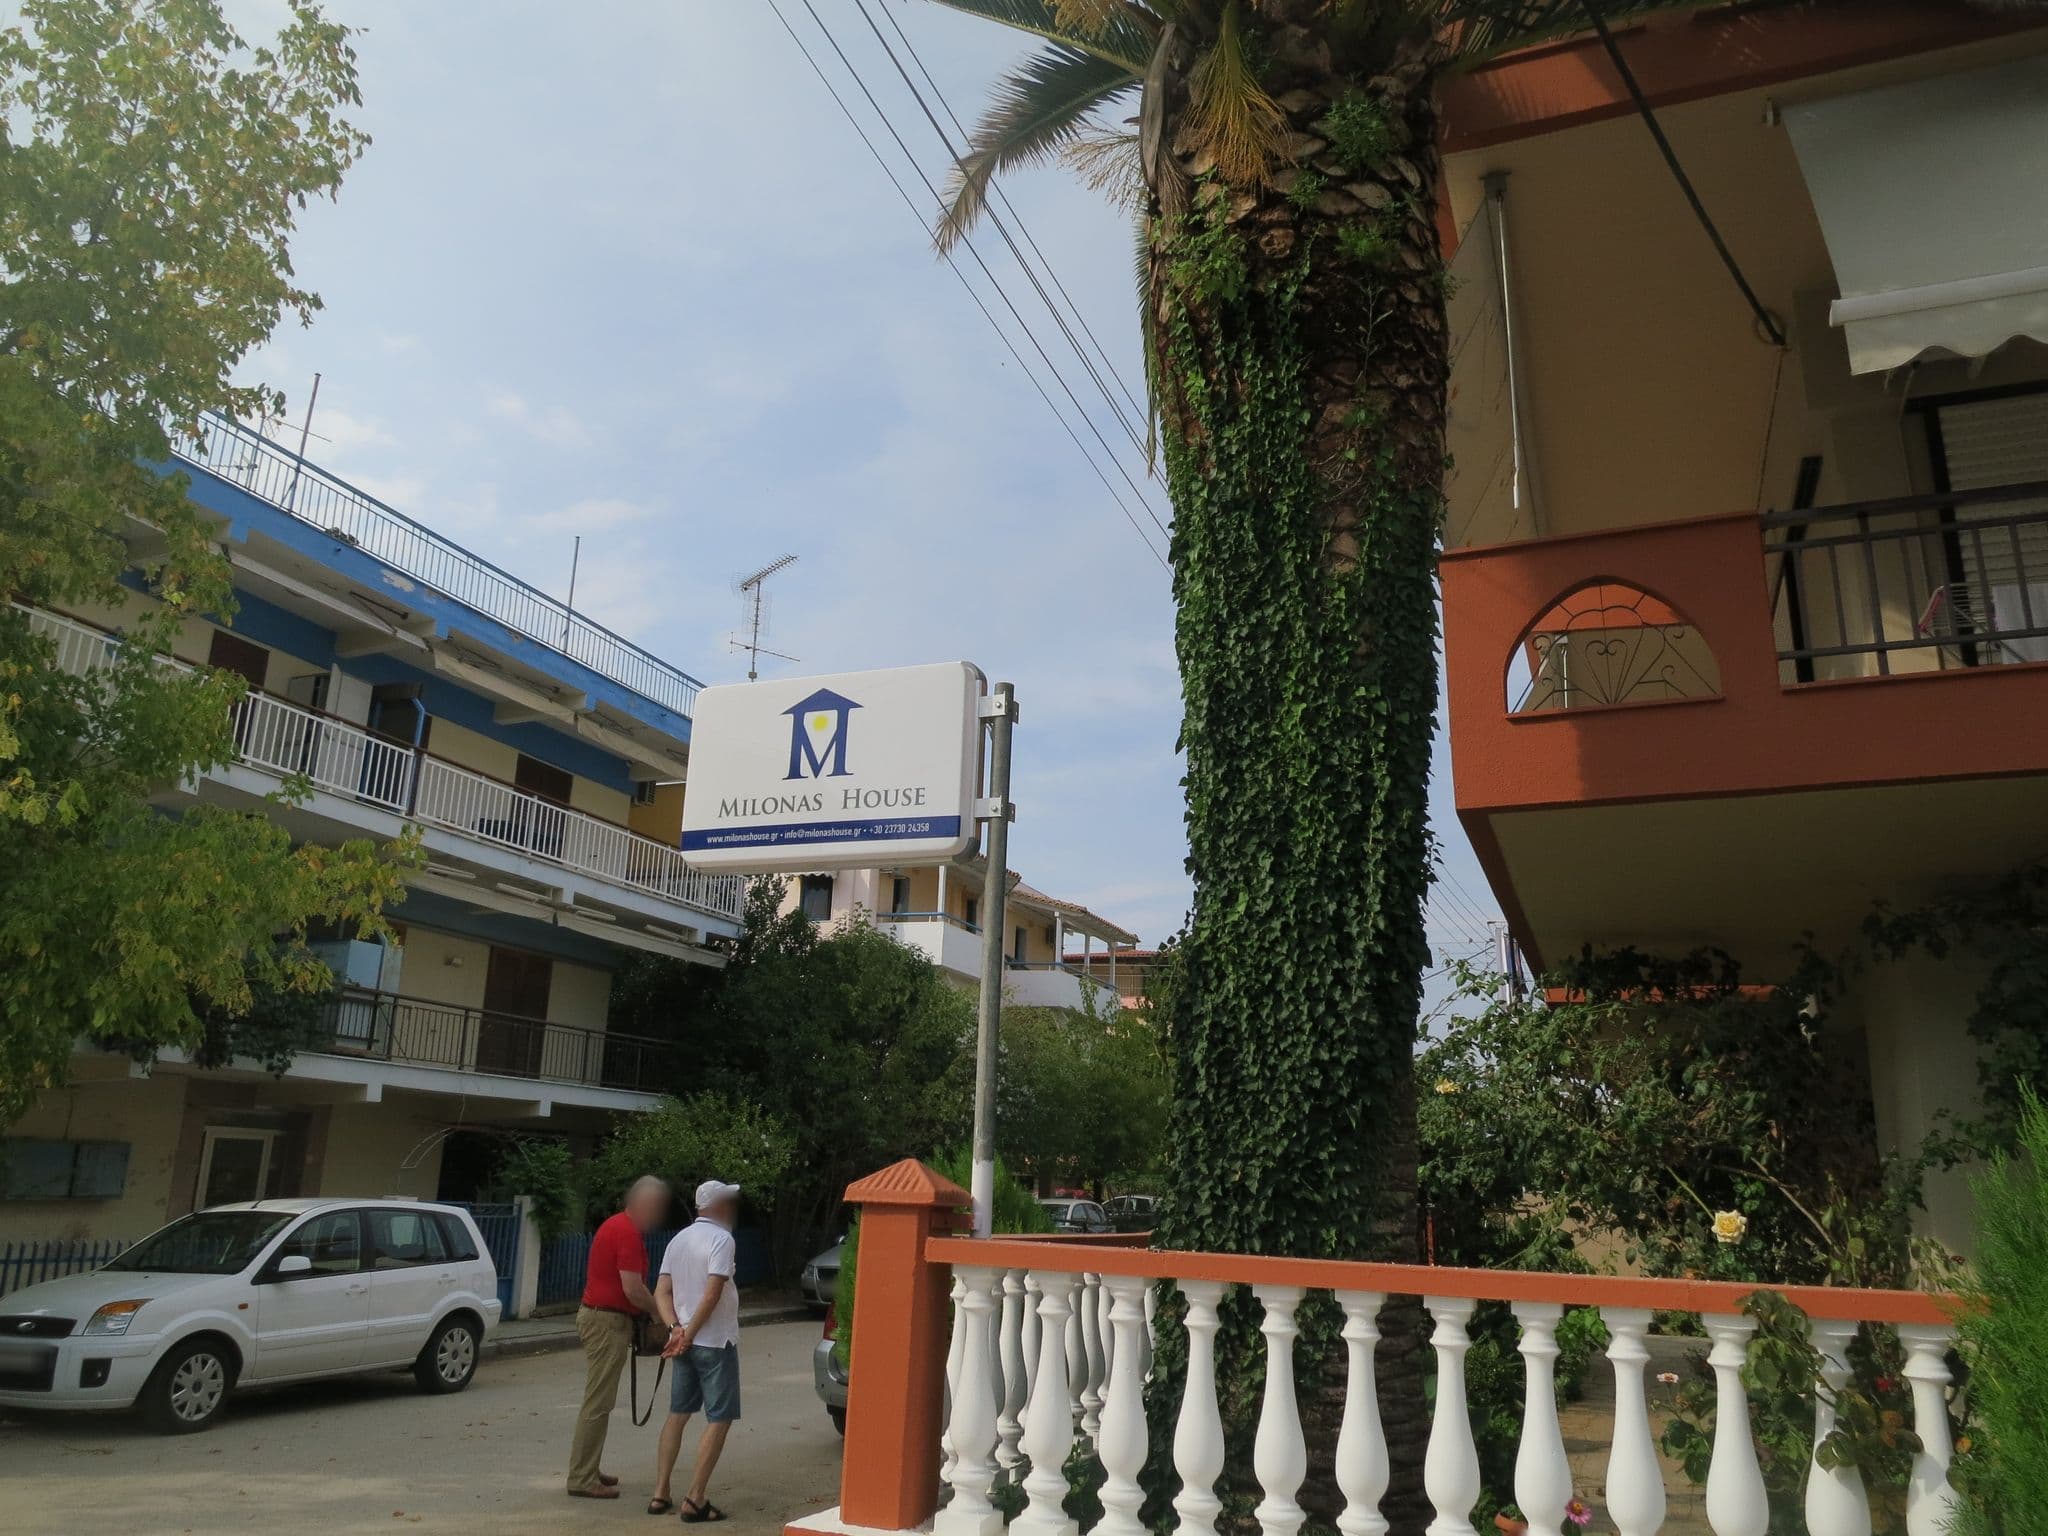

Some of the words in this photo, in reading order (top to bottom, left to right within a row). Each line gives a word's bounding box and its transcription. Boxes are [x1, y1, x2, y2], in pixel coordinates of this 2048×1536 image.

[718, 793, 823, 818] MILONAS
[841, 787, 926, 810] HOUSE
[706, 832, 779, 844] www.milonashouse.gr
[784, 827, 862, 840] info@milonashouse.gr
[869, 825, 882, 834] +30
[884, 824, 906, 834] 23730
